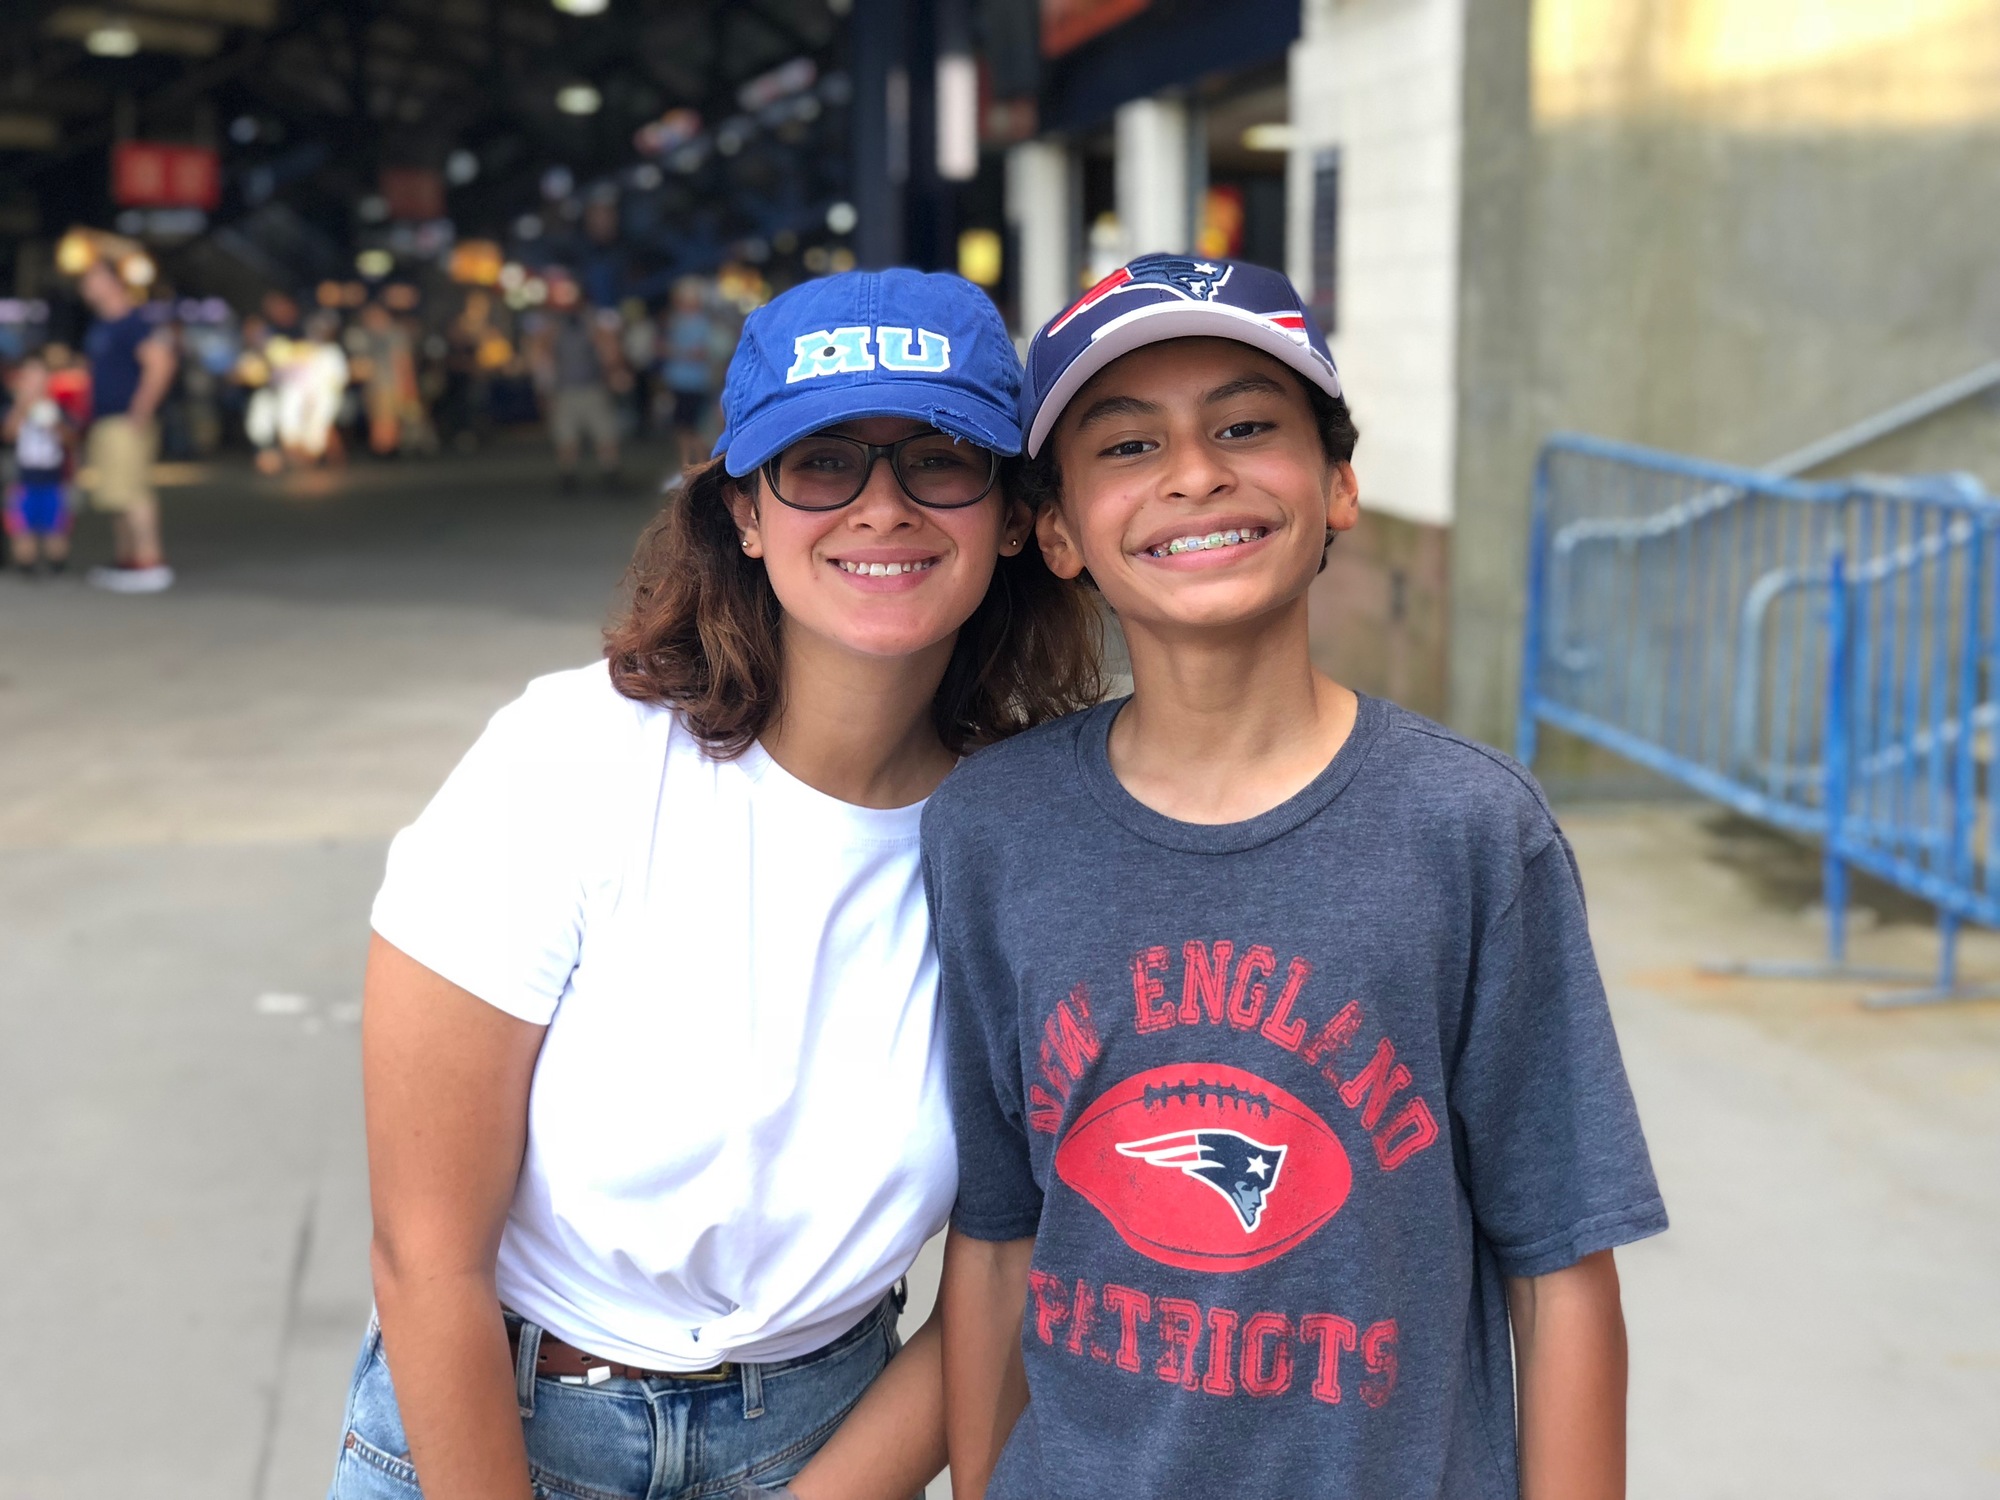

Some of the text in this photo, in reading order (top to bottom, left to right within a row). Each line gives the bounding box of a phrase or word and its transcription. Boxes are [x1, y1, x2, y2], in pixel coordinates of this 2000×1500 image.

[786, 326, 951, 384] MU
[1131, 940, 1439, 1171] ENGLAND
[1028, 1270, 1398, 1408] PATRIOTS
